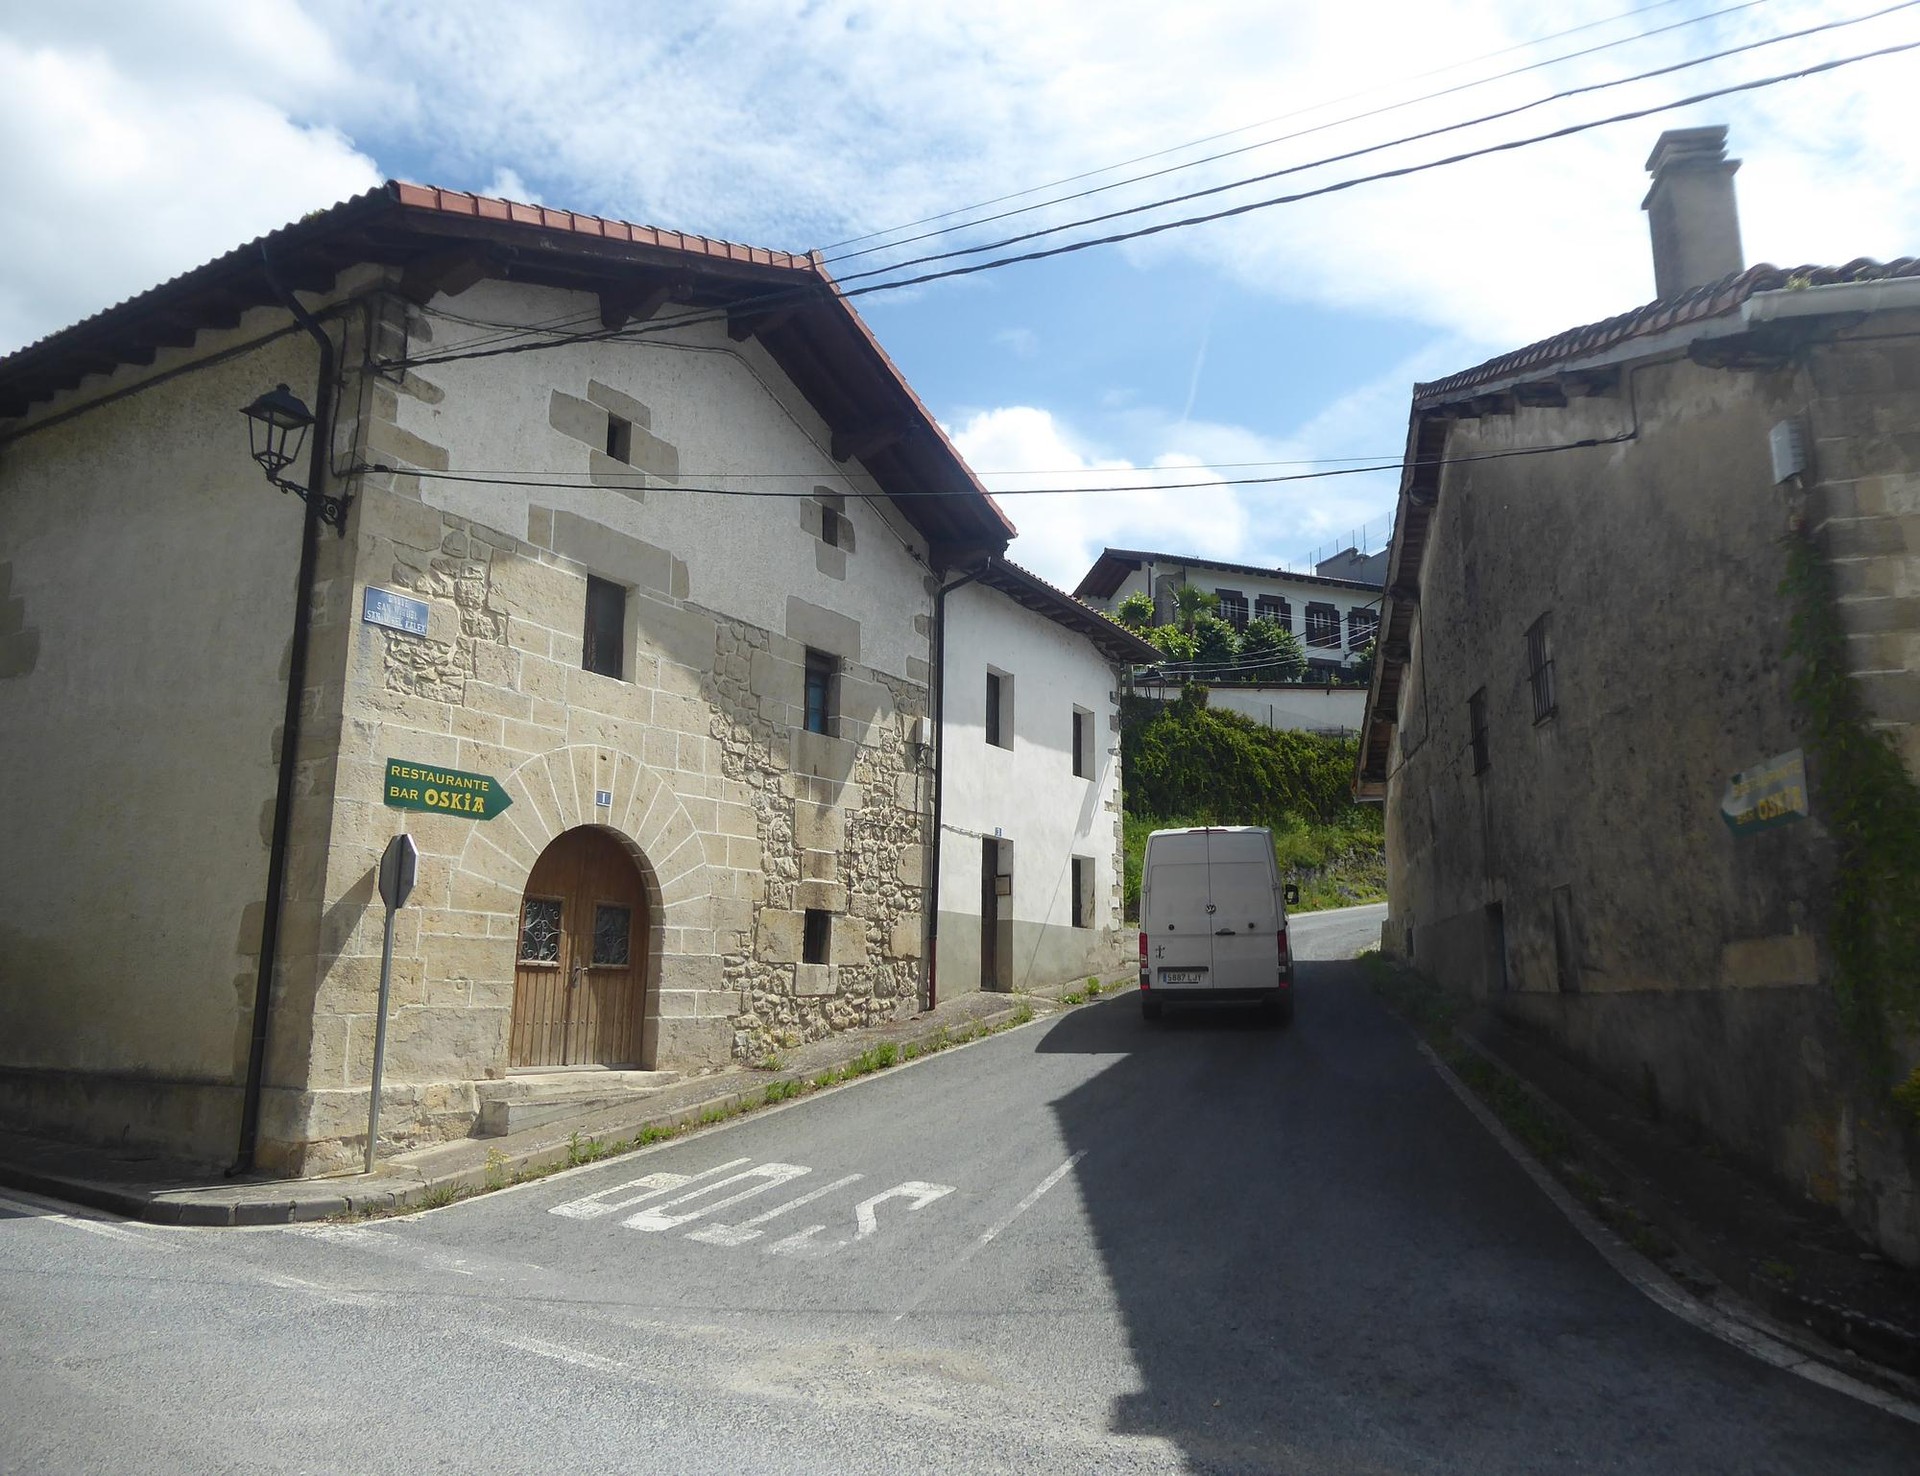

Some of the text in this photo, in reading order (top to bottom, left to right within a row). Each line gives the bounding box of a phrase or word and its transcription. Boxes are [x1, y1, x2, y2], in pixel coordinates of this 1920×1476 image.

[391, 765, 490, 792] RESTAURANTE
[390, 786, 419, 800] BAR
[547, 1157, 958, 1256] STOP
